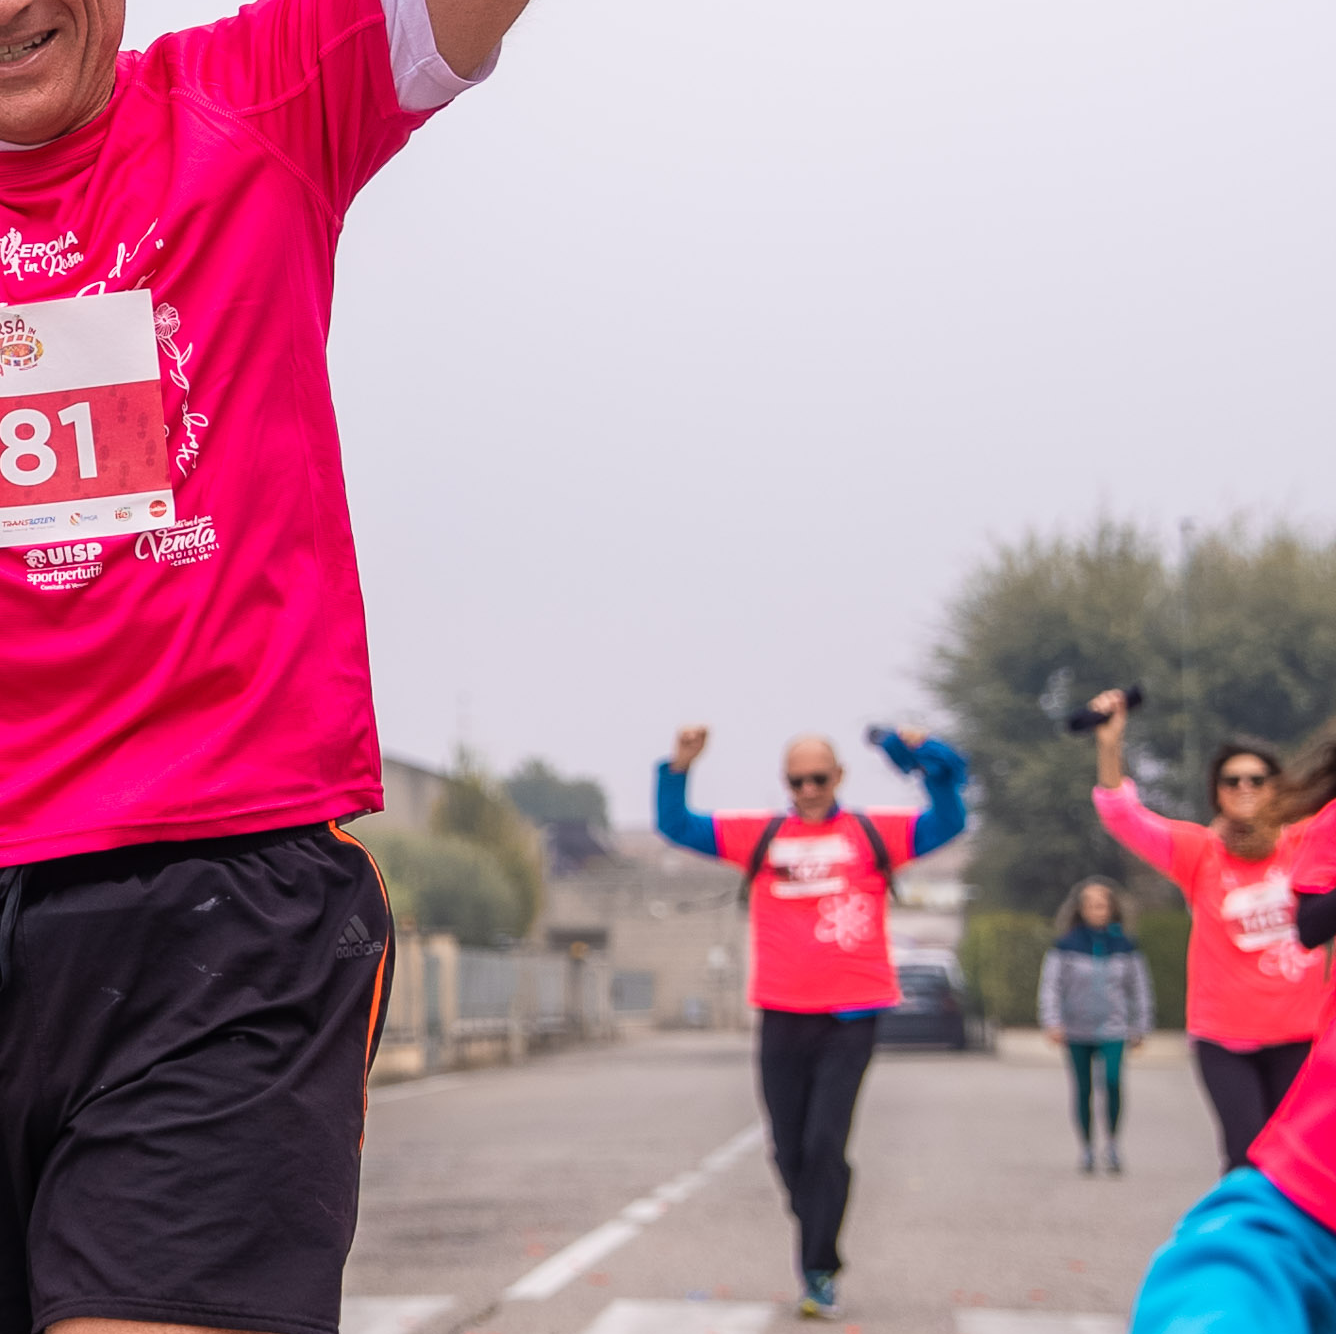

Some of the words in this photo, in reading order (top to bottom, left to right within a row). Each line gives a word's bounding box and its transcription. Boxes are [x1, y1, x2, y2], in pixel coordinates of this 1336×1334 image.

[24, 260, 40, 274] in
[42, 251, 84, 277] Rosa
[46, 542, 103, 566] UISP
[134, 522, 217, 564] Veneta
[336, 940, 384, 959] adidas
